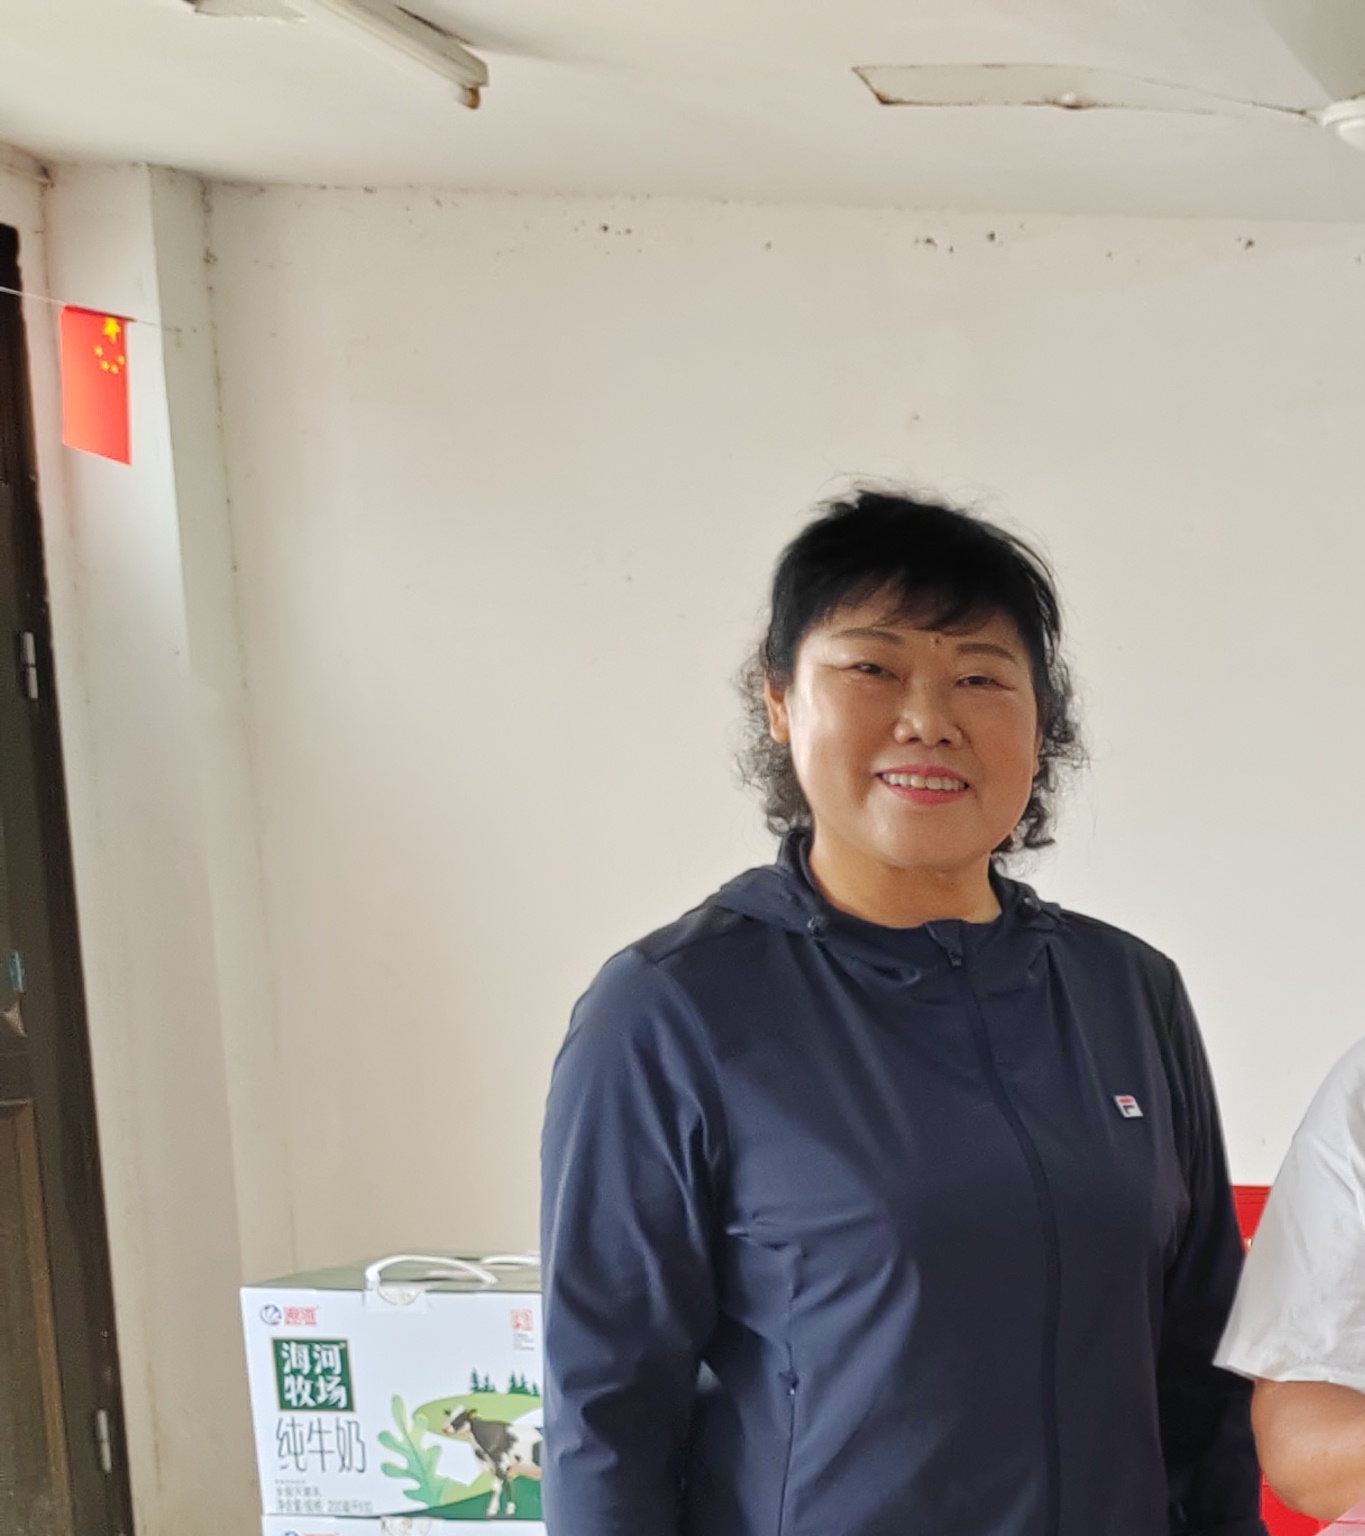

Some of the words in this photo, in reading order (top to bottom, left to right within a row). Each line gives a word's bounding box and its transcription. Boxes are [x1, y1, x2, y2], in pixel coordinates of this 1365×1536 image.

[282, 1342, 342, 1374] 海河
[284, 1376, 347, 1410] 牧场
[276, 1417, 366, 1473] 纯牛奶
